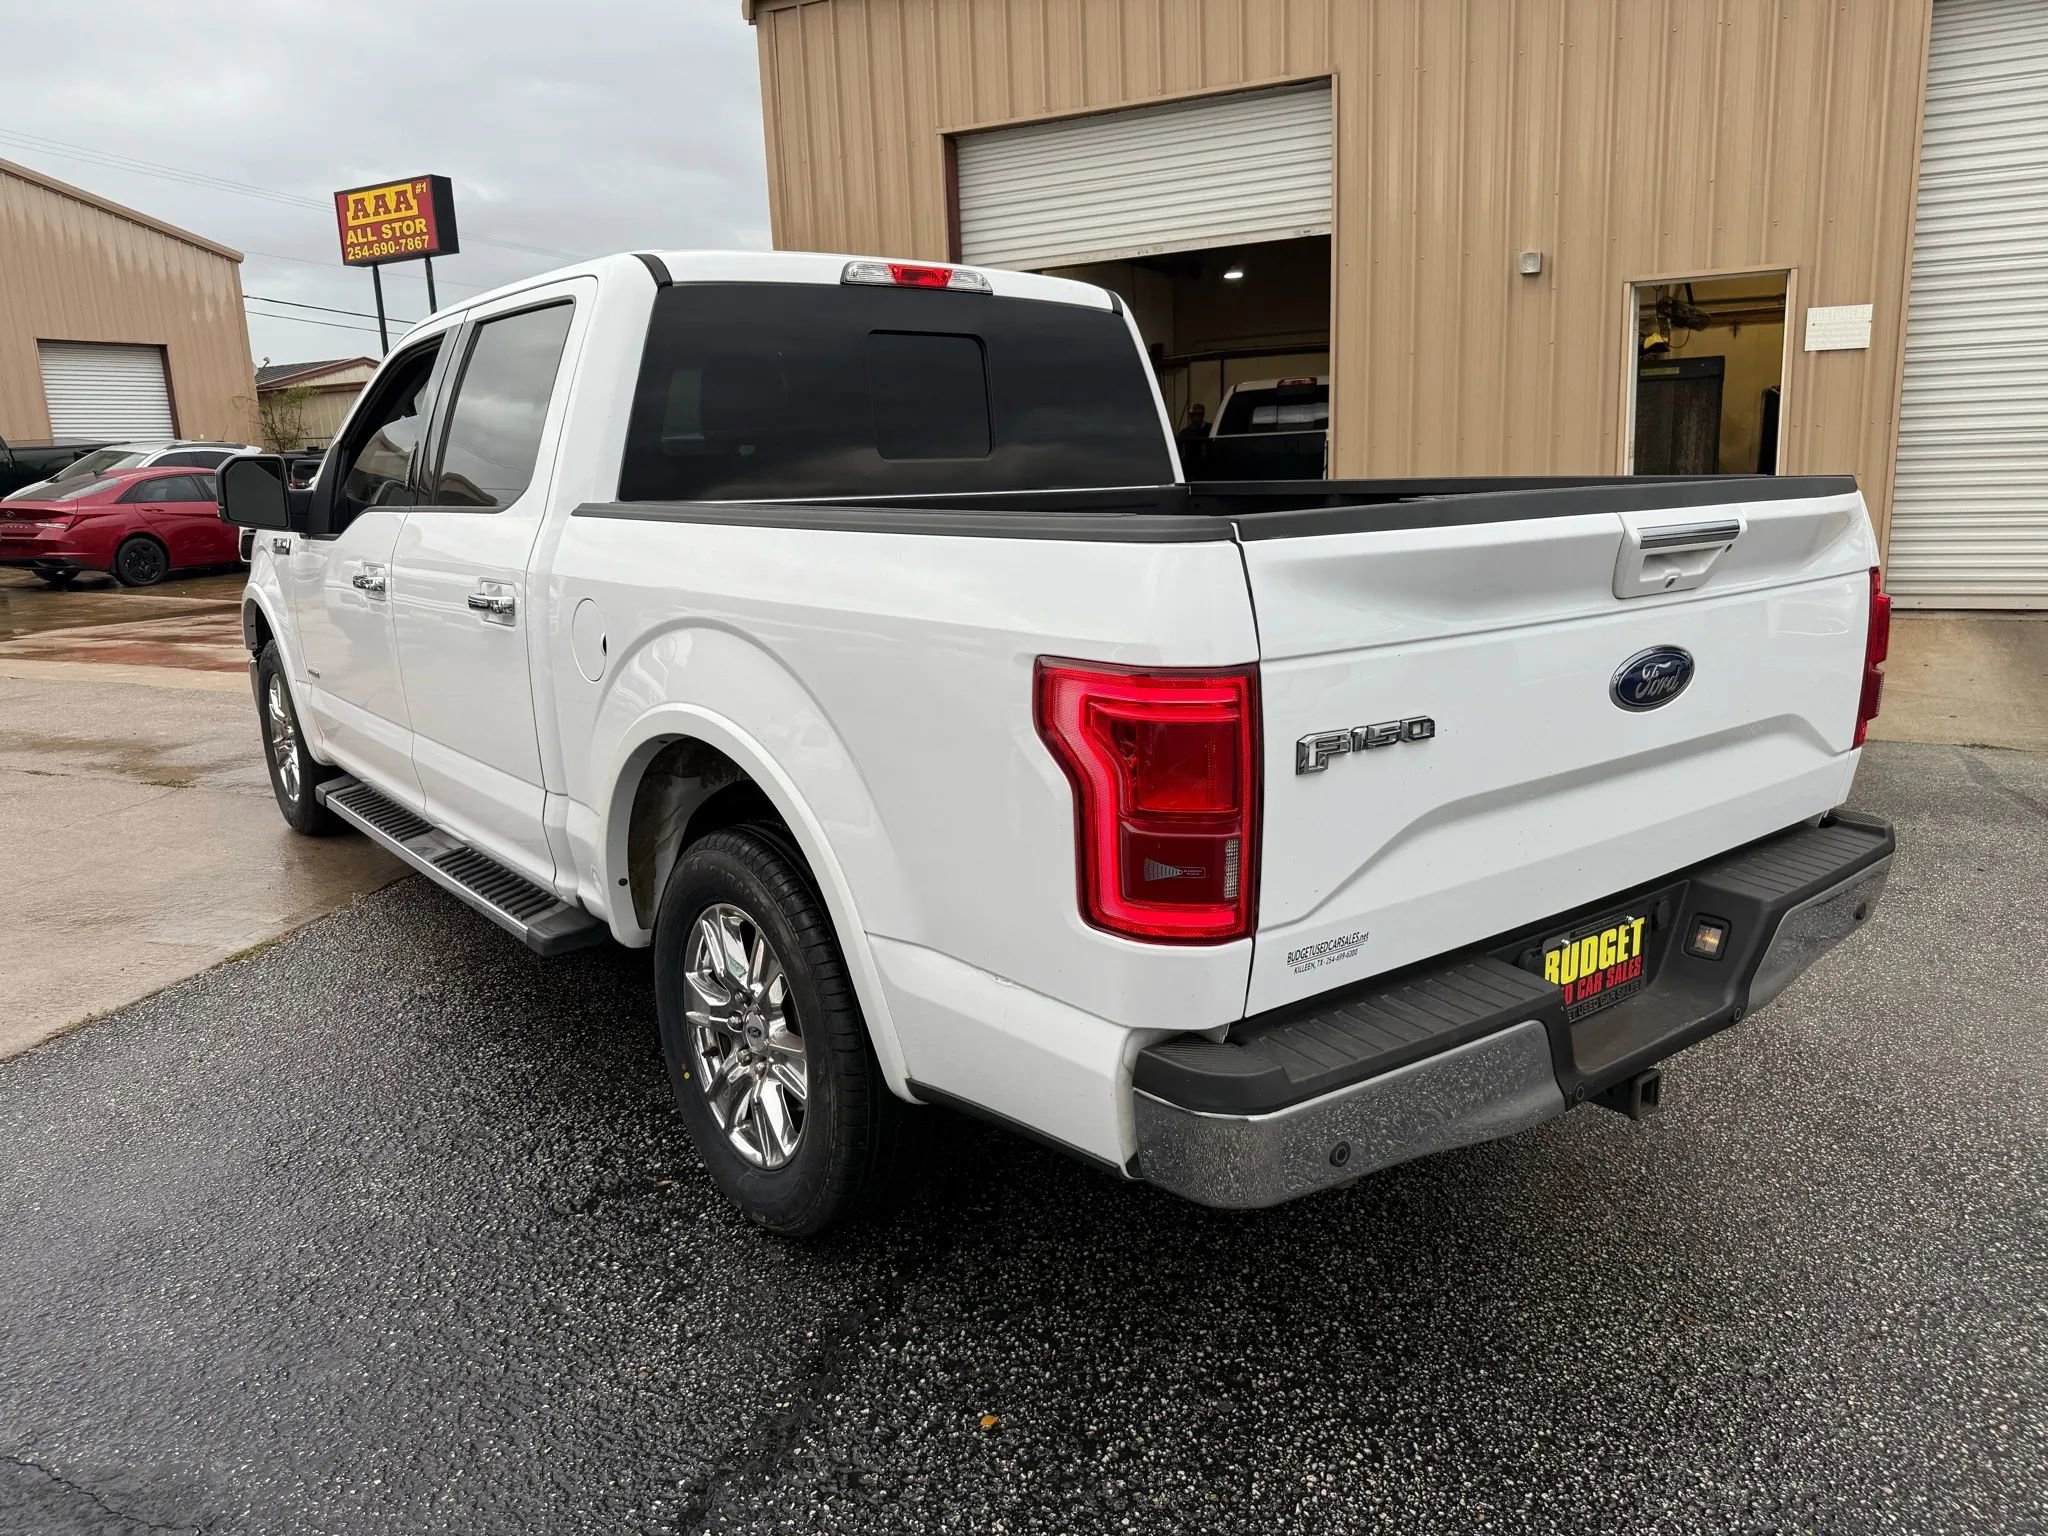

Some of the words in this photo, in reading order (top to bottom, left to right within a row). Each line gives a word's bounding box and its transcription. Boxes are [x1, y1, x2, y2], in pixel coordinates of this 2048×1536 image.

[351, 188, 414, 221] AAA
[415, 182, 427, 194] #1
[346, 226, 377, 244] ALL
[381, 218, 428, 239] STOR
[347, 235, 429, 260] 254-690-7867
[1635, 661, 1681, 699] Ford
[1286, 931, 1369, 964] BUDGETUSEDCARSALES.net
[1544, 917, 1645, 985] BUDGET
[1577, 971, 1603, 1001] CAR
[1606, 955, 1643, 989] SALES
